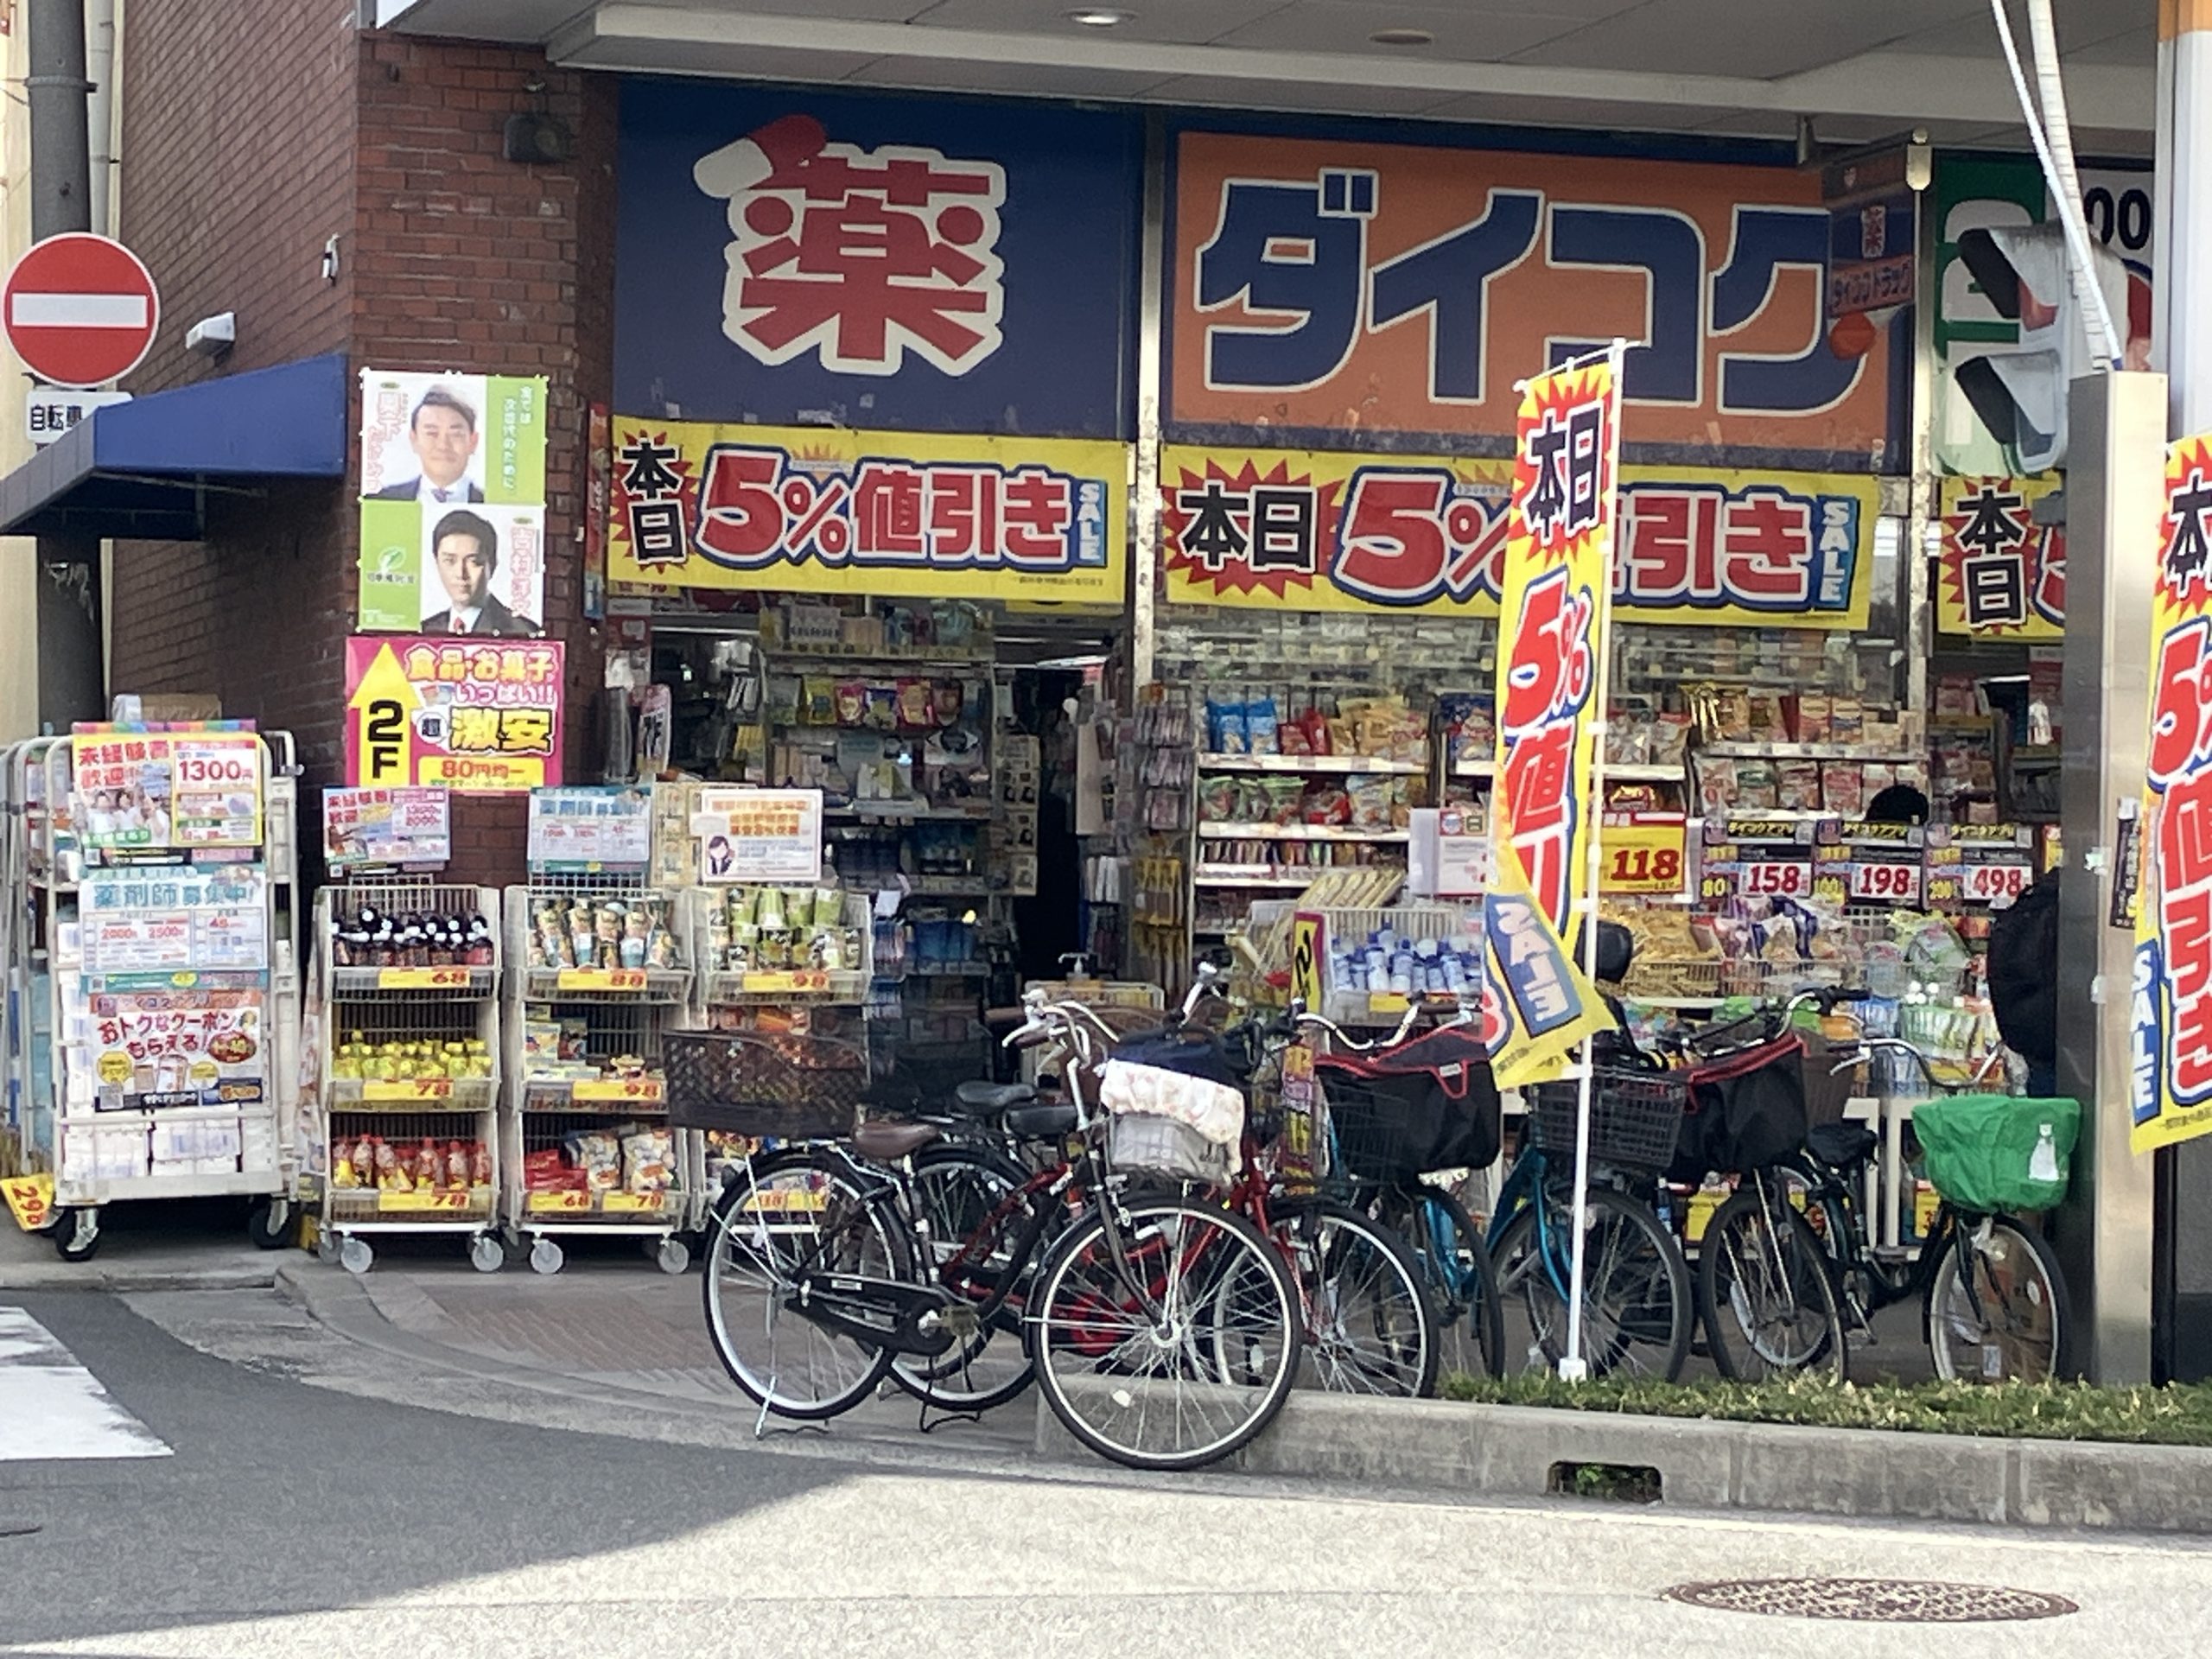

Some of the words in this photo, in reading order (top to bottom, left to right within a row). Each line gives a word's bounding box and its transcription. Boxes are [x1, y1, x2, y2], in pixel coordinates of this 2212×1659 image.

[695, 114, 1007, 378] 薬
[1194, 167, 1869, 416] ダイコク
[620, 435, 687, 565] 本日
[695, 444, 1071, 568] 5%値引き
[1077, 481, 1102, 562] SALE
[1522, 400, 1604, 545] 本日
[1177, 480, 1318, 575] 本日
[1335, 473, 1813, 605] 5%引き
[1818, 500, 1851, 603] SALE
[1955, 485, 2027, 628] 本日
[367, 700, 404, 779] 2F
[449, 706, 552, 753] 激安
[1611, 849, 1680, 881] 118
[1748, 865, 1801, 893] 158
[1860, 866, 1910, 896] 198
[1974, 868, 2023, 897] 498
[98, 1012, 236, 1045] おトクなクーポン
[2131, 949, 2155, 1111] SALE
